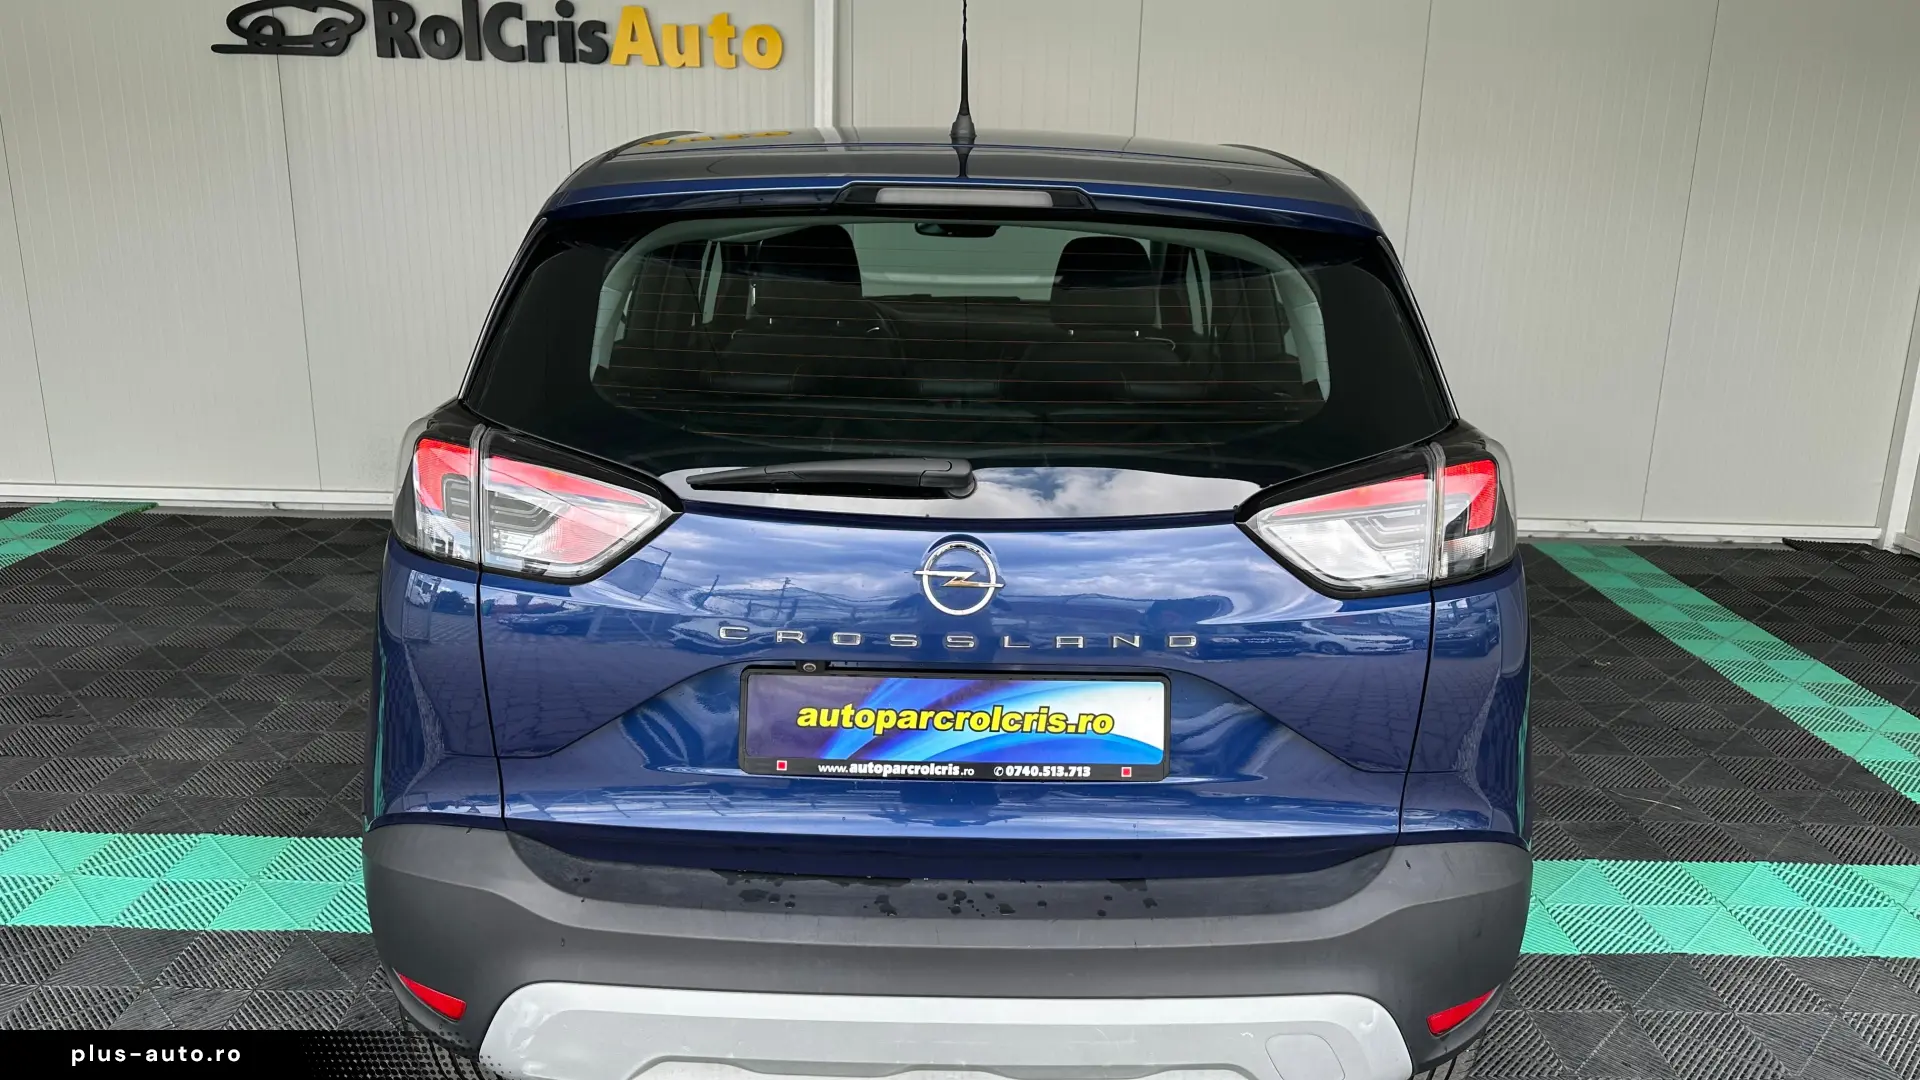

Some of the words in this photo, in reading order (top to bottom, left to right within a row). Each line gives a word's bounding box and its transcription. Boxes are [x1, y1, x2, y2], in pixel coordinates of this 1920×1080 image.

[718, 625, 1198, 649] CROSSLAND
[796, 703, 1115, 735] autoparcrolcris.ro
[817, 760, 975, 778] www.autoparcrolcris.ro
[1004, 764, 1092, 778] 0740.513.713
